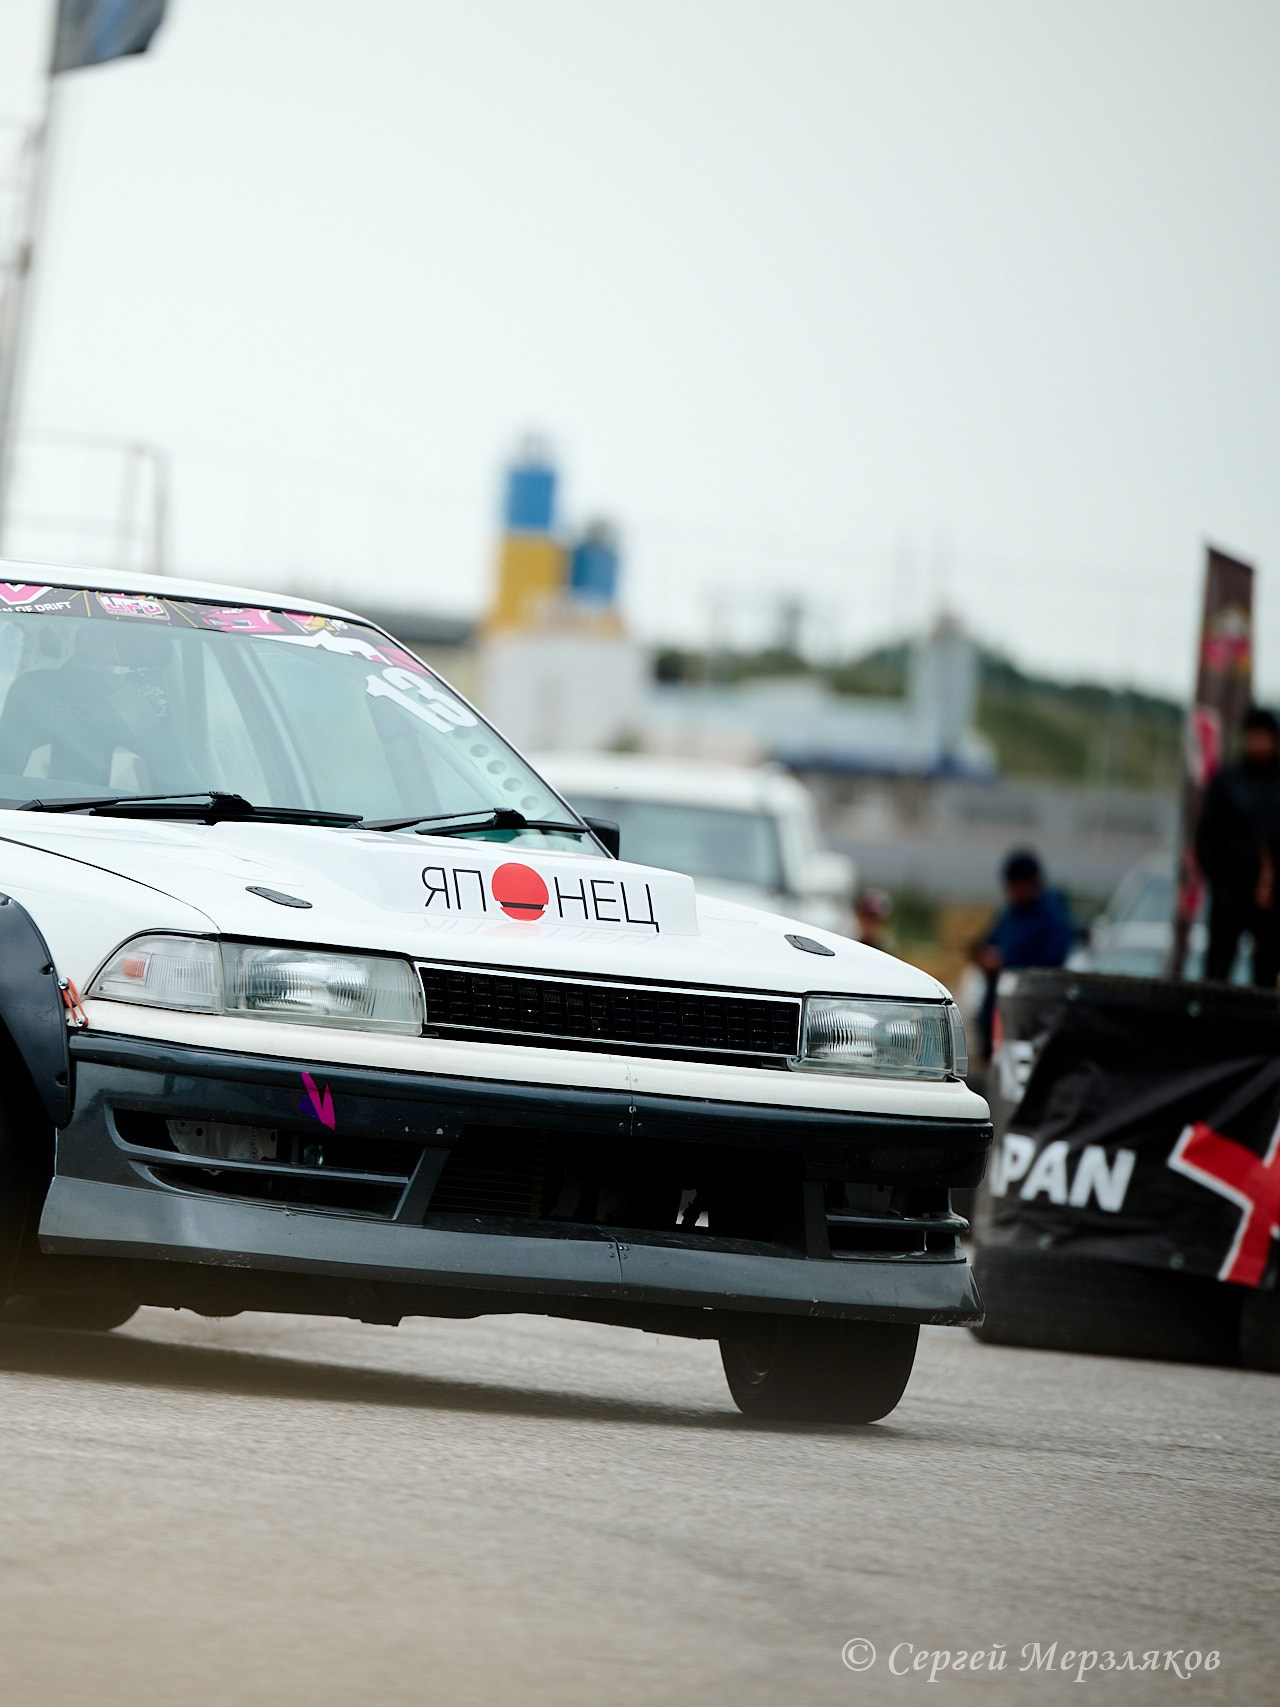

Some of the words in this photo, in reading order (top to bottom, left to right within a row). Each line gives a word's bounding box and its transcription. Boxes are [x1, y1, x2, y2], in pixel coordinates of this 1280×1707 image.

[34, 601, 72, 613] DRIFT
[365, 667, 478, 734] 13
[990, 1134, 1136, 1213] PAN
